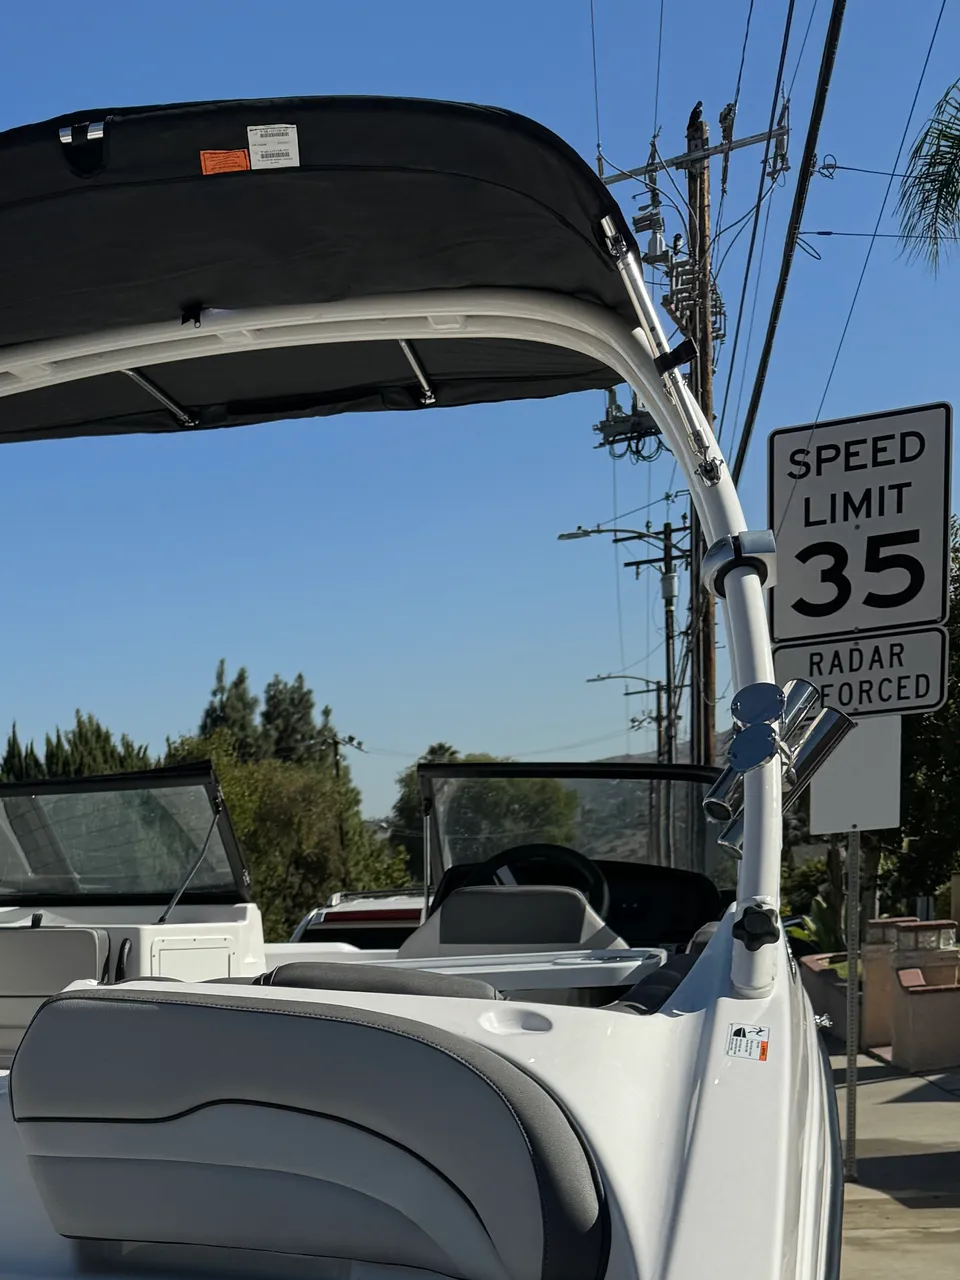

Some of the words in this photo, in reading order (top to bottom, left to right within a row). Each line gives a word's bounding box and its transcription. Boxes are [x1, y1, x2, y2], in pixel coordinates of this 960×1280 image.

[787, 431, 926, 480] SPEED
[804, 482, 912, 528] LIMIT
[790, 529, 926, 618] 35
[809, 643, 904, 677] RADAR
[820, 674, 930, 708] FORCED
